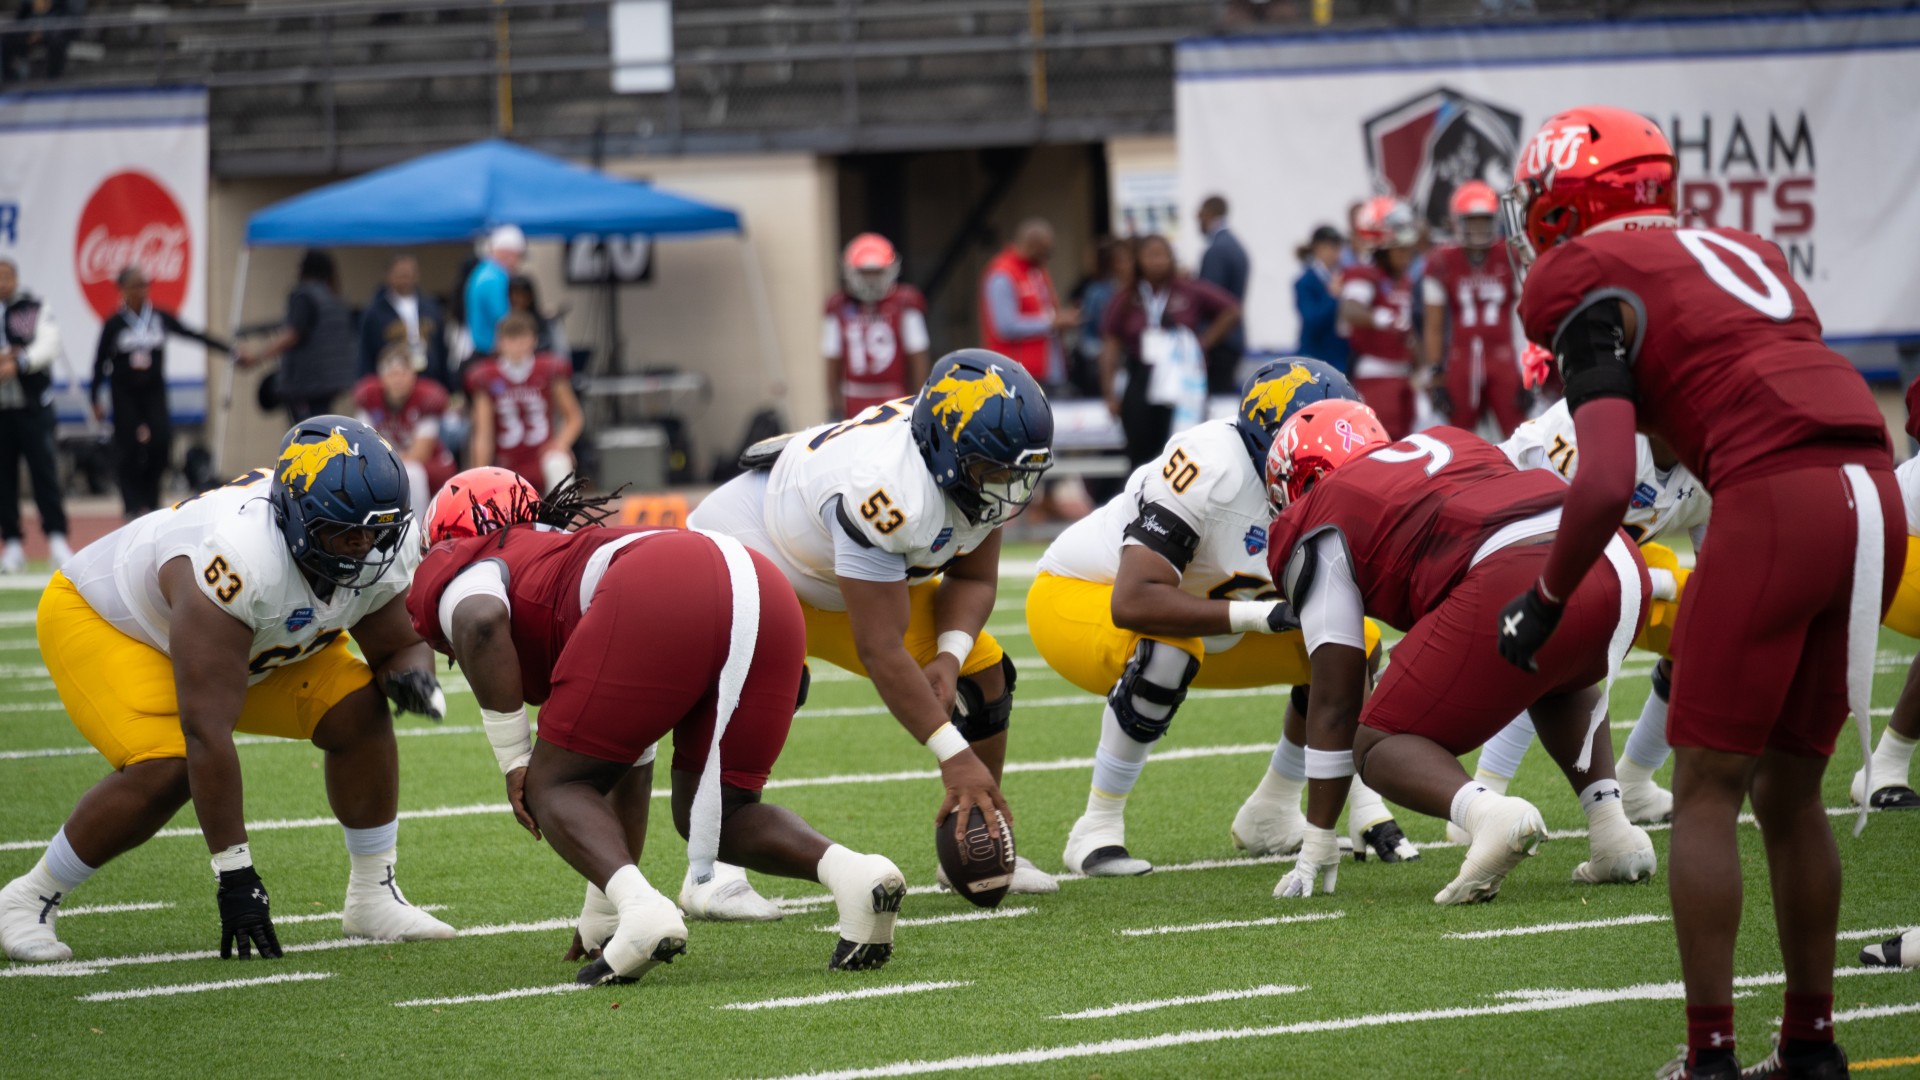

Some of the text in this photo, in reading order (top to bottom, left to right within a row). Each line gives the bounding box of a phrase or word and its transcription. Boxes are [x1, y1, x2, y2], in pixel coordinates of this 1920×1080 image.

[1671, 112, 1816, 172] HAM
[1681, 177, 1816, 235] RTS
[1674, 228, 1795, 322] 0
[846, 322, 897, 376] 19
[497, 397, 549, 449] 33
[1162, 447, 1201, 495] 50
[1547, 433, 1577, 479] 71
[860, 487, 907, 536] 53
[204, 554, 243, 604] 63
